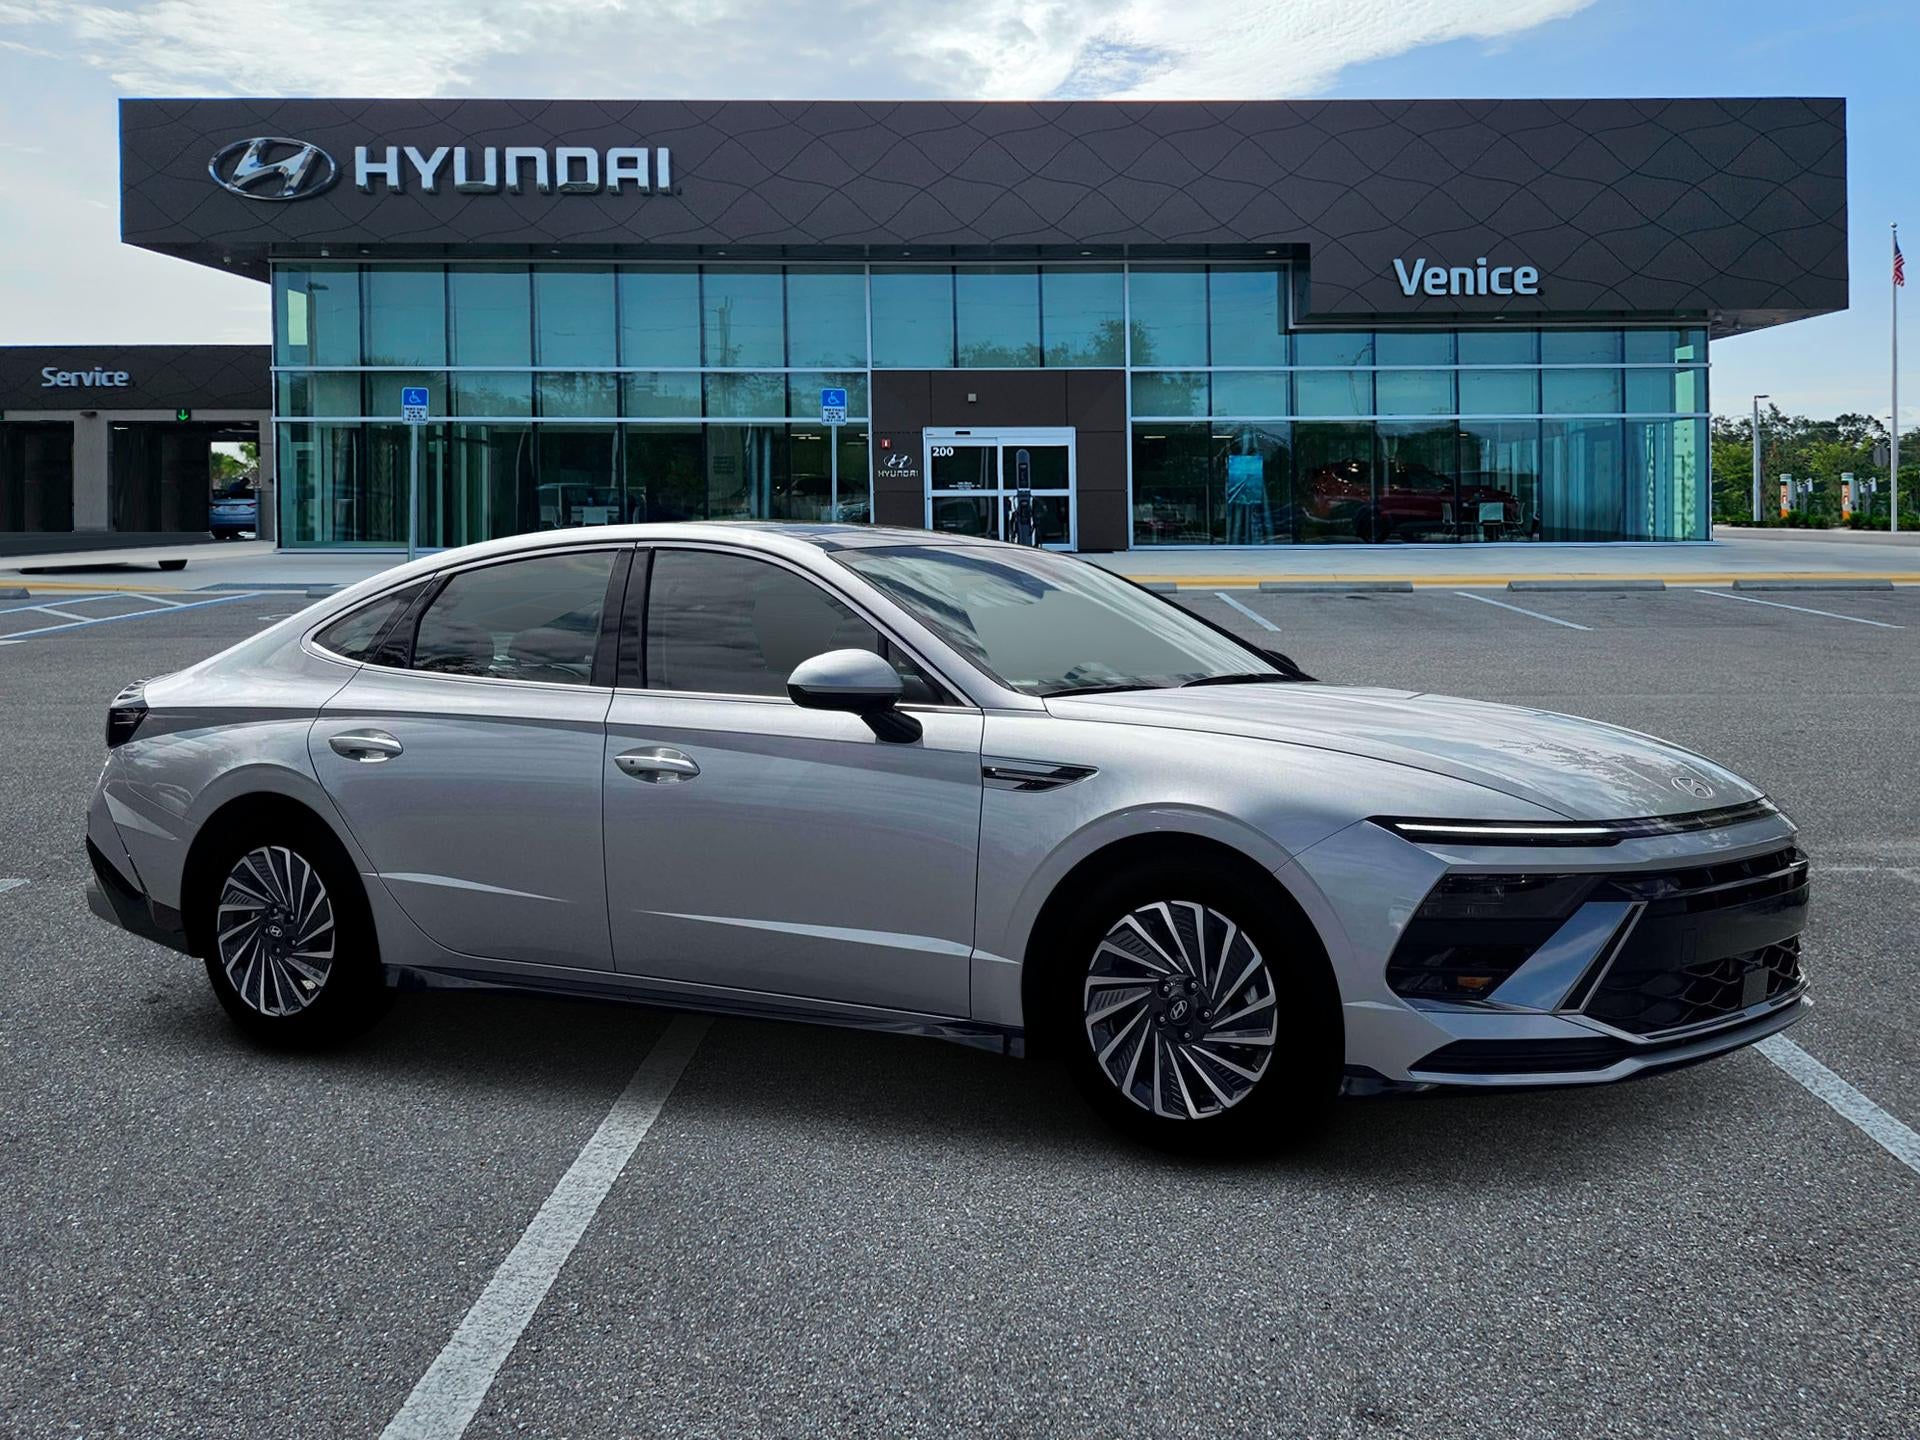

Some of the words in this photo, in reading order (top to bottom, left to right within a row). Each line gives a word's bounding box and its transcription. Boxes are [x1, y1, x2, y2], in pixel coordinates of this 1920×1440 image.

[354, 146, 671, 194] HYUNDAI
[1392, 256, 1540, 296] Venice
[41, 366, 130, 388] Service
[932, 447, 955, 457] 200
[878, 470, 919, 478] HYUNDAI
